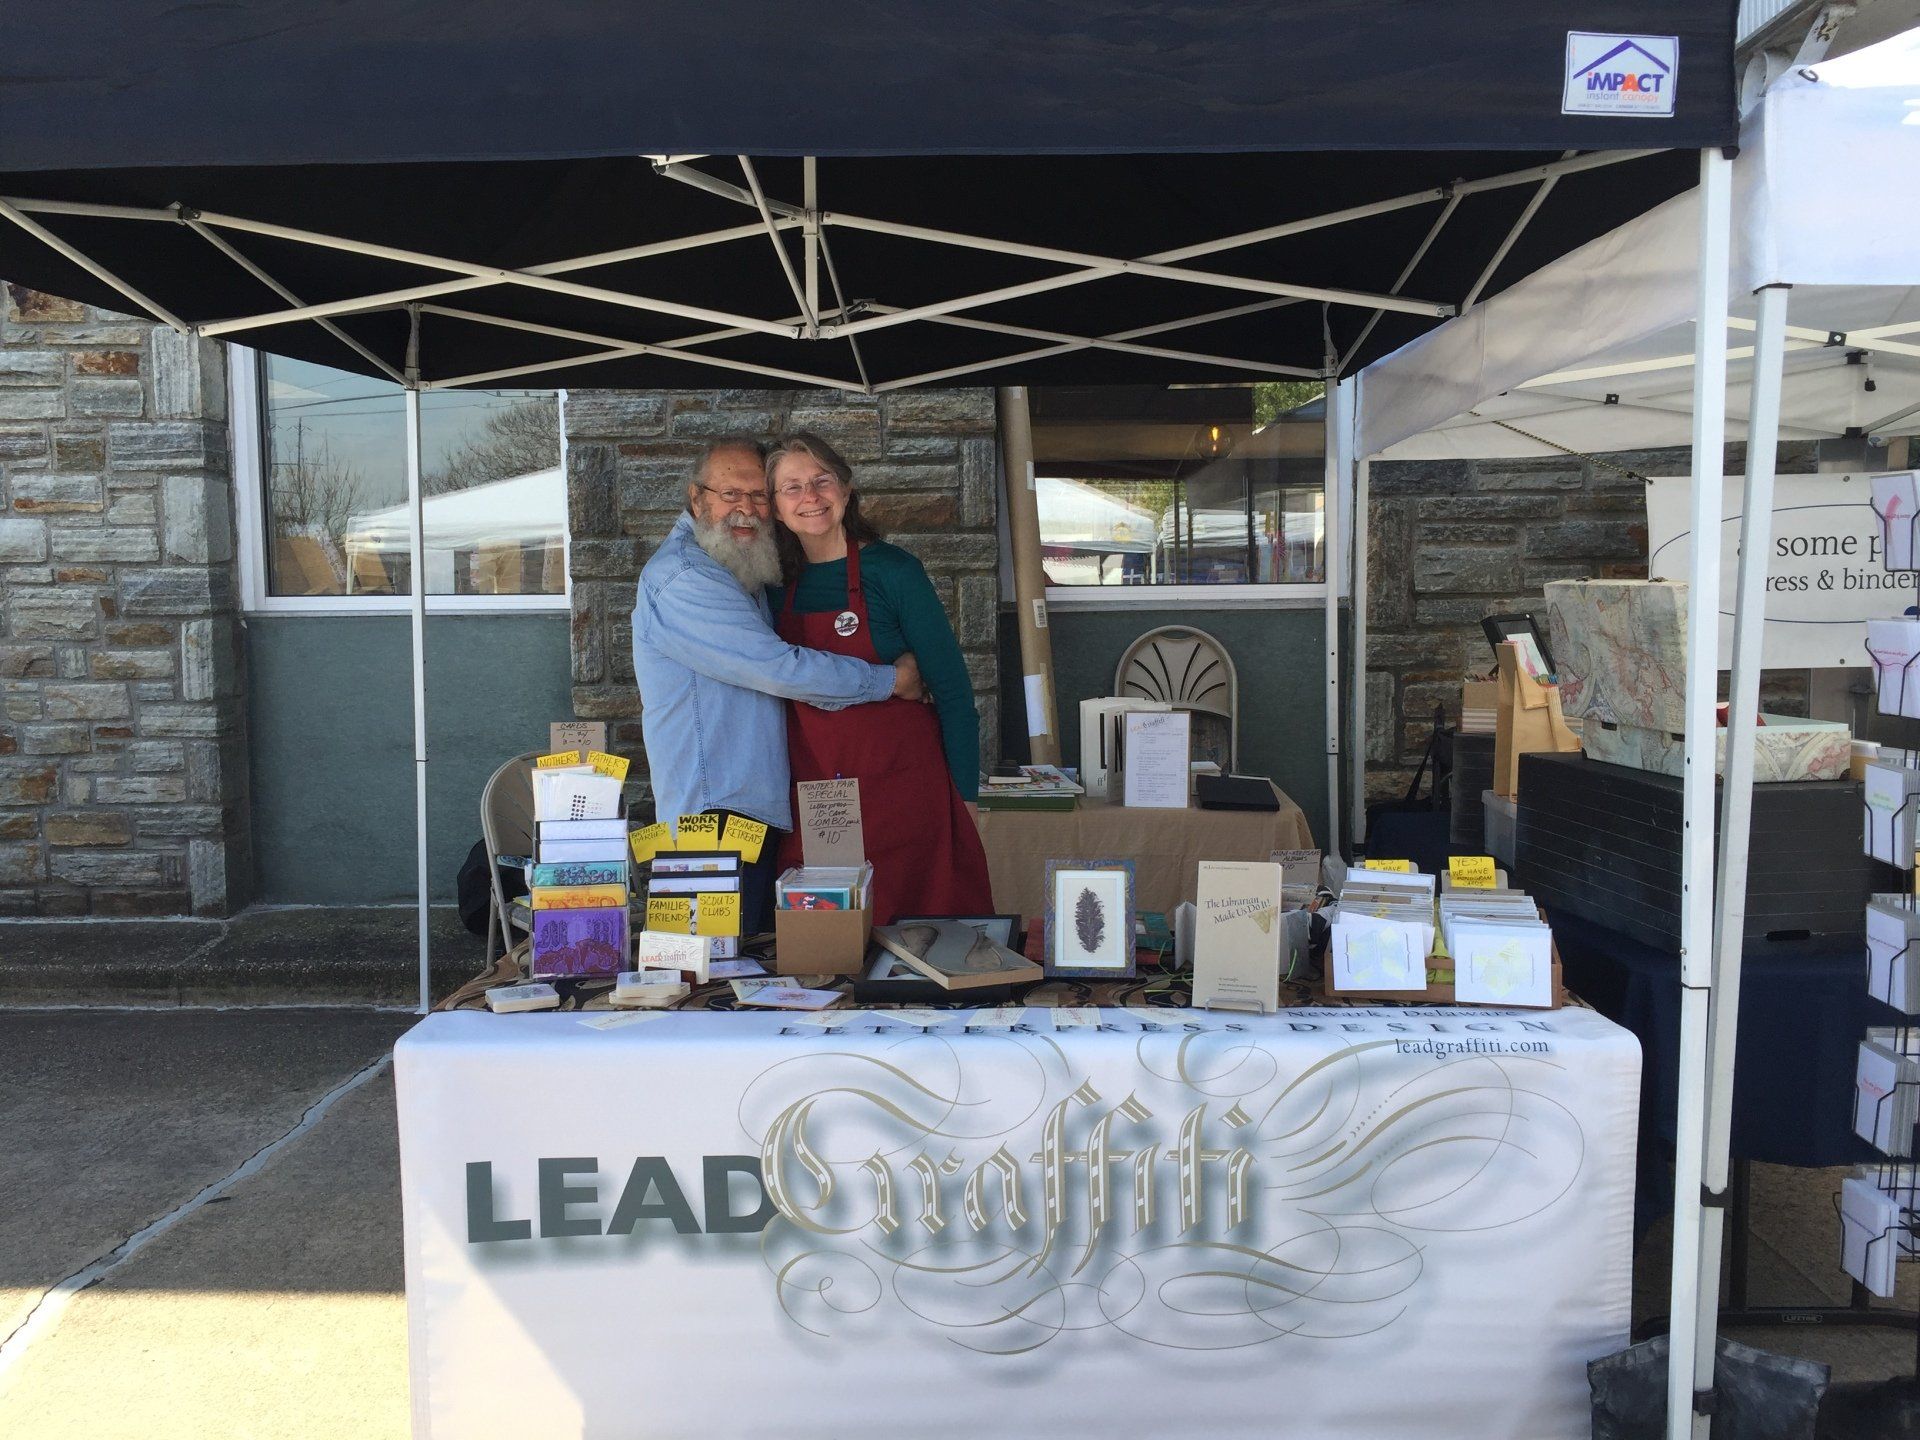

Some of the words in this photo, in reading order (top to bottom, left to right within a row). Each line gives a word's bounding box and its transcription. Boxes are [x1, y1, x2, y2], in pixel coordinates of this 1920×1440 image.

[1587, 92, 1619, 101] instant
[1621, 93, 1658, 103] canopy
[1776, 535, 1857, 556] some
[1766, 575, 1808, 592] ress
[1817, 569, 1834, 592] &
[807, 790, 848, 799] SPECIAL
[679, 815, 718, 825] WORK
[729, 816, 765, 834] BUSINESS
[807, 817, 846, 827] COMBO
[678, 824, 714, 833] SHOPS
[726, 827, 763, 845] RETREATS
[1454, 857, 1483, 867] YES!
[1467, 867, 1489, 875] HAVE
[648, 900, 690, 912] FAMILIES
[699, 895, 735, 906] SCOUTS
[1205, 899, 1220, 909] The
[1221, 896, 1259, 908] Librarian
[701, 907, 731, 917] CLUBS
[1214, 909, 1235, 925] Made
[1235, 907, 1247, 917] Us
[1248, 903, 1260, 914] Do
[648, 913, 690, 924] FRIENDS
[1286, 1009, 1391, 1018] Newark,
[1402, 1009, 1519, 1018] Delaware
[1287, 1020, 1556, 1033] DESIGN
[1395, 1037, 1550, 1060] leadgraffiti.com
[466, 1155, 777, 1244] LEAD
